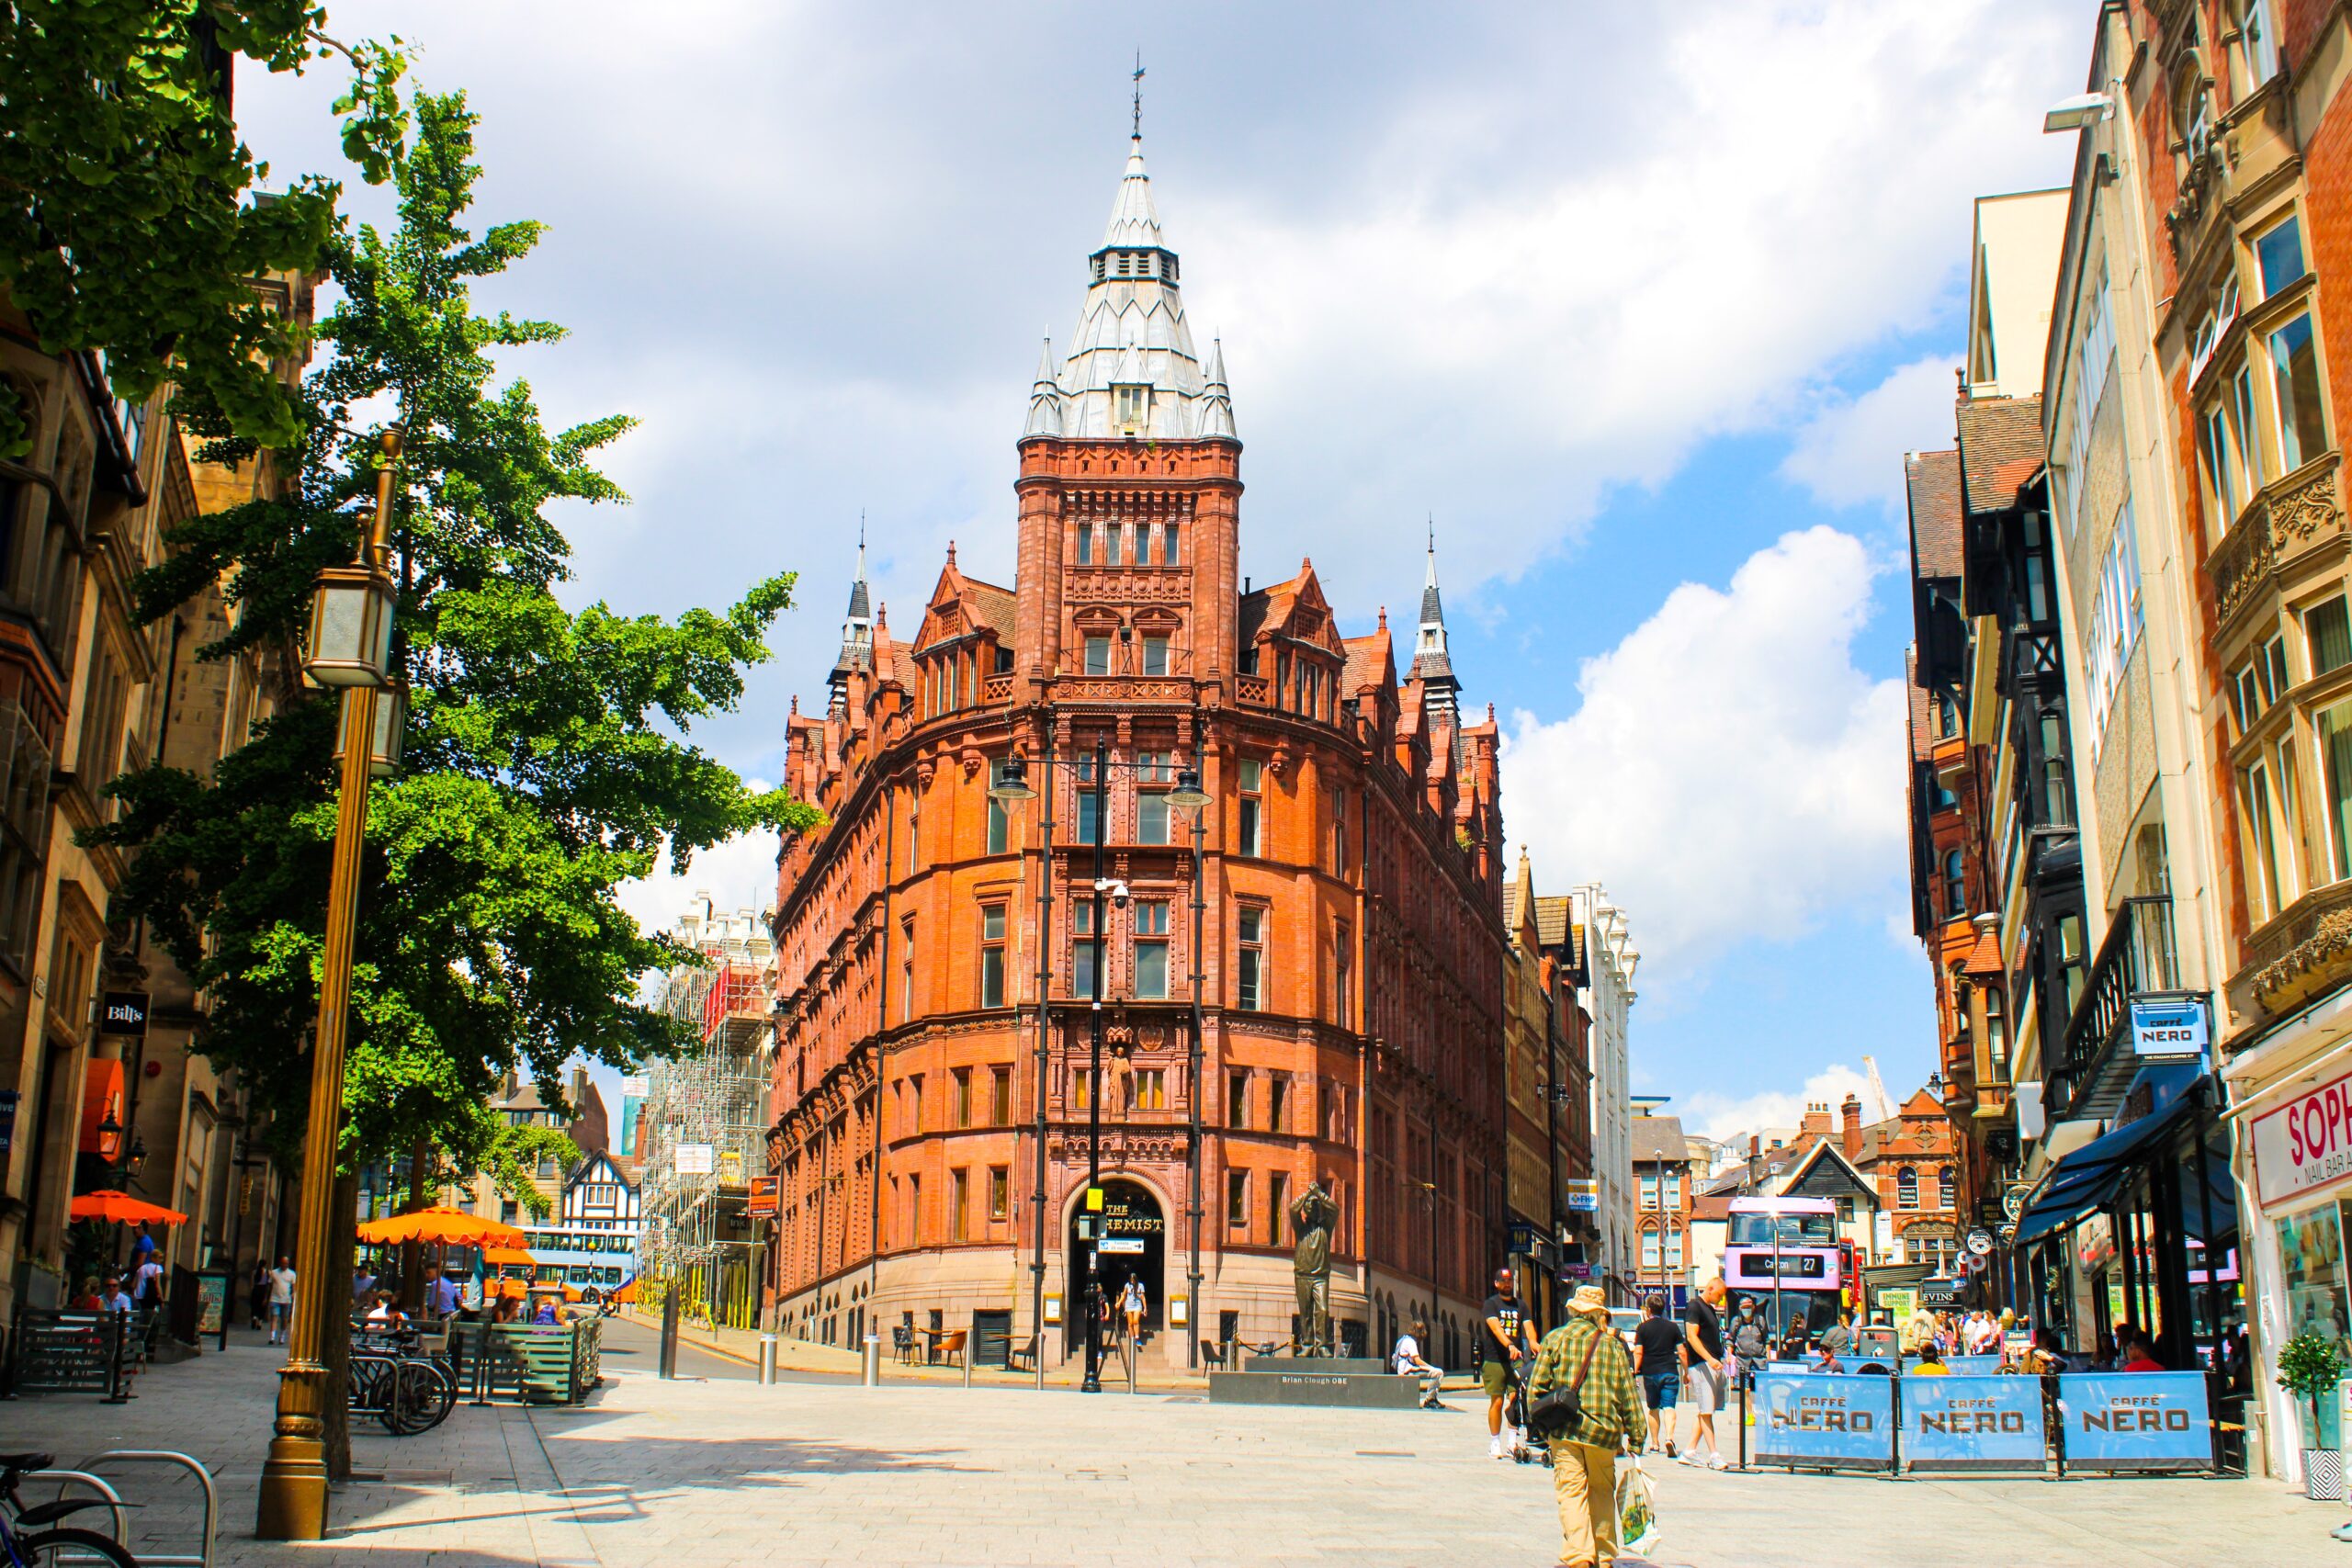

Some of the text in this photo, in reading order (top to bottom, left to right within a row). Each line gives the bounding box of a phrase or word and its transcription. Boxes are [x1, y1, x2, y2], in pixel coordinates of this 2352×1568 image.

[107, 1005, 143, 1022] Bill's
[2142, 1030, 2192, 1043] NERO
[2304, 1163, 2325, 1185] NAIL
[2325, 1155, 2345, 1178] BAR
[1580, 1195, 1596, 1203] FHP
[1106, 1204, 1128, 1213] THE
[1072, 1218, 1163, 1231] AHEMIST
[1804, 1258, 1815, 1271] 27
[1282, 1376, 1348, 1385] Brian Clough OBE
[1801, 1396, 1846, 1407] CAFFÈ
[1948, 1397, 1996, 1408] CAFFÈ
[2111, 1394, 2160, 1405] CAFFÈ
[1773, 1408, 1873, 1432] NERO
[1920, 1411, 2024, 1434] NERO
[2082, 1408, 2189, 1432] NERO
